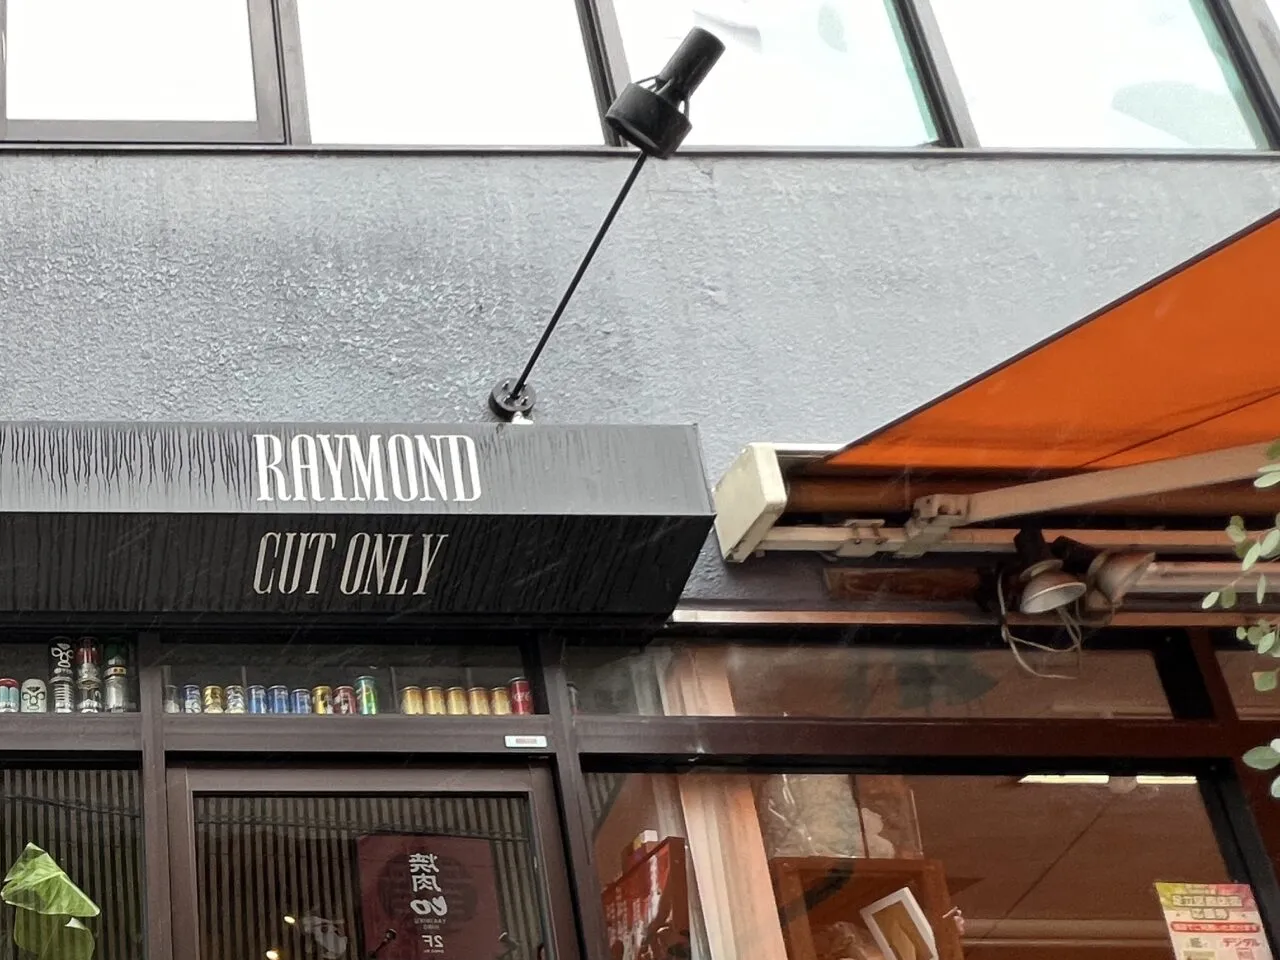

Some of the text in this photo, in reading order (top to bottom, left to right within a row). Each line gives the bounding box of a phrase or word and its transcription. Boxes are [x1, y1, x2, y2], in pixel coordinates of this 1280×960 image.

[252, 433, 482, 502] RAYMOND
[253, 531, 449, 597] CUT ONLY
